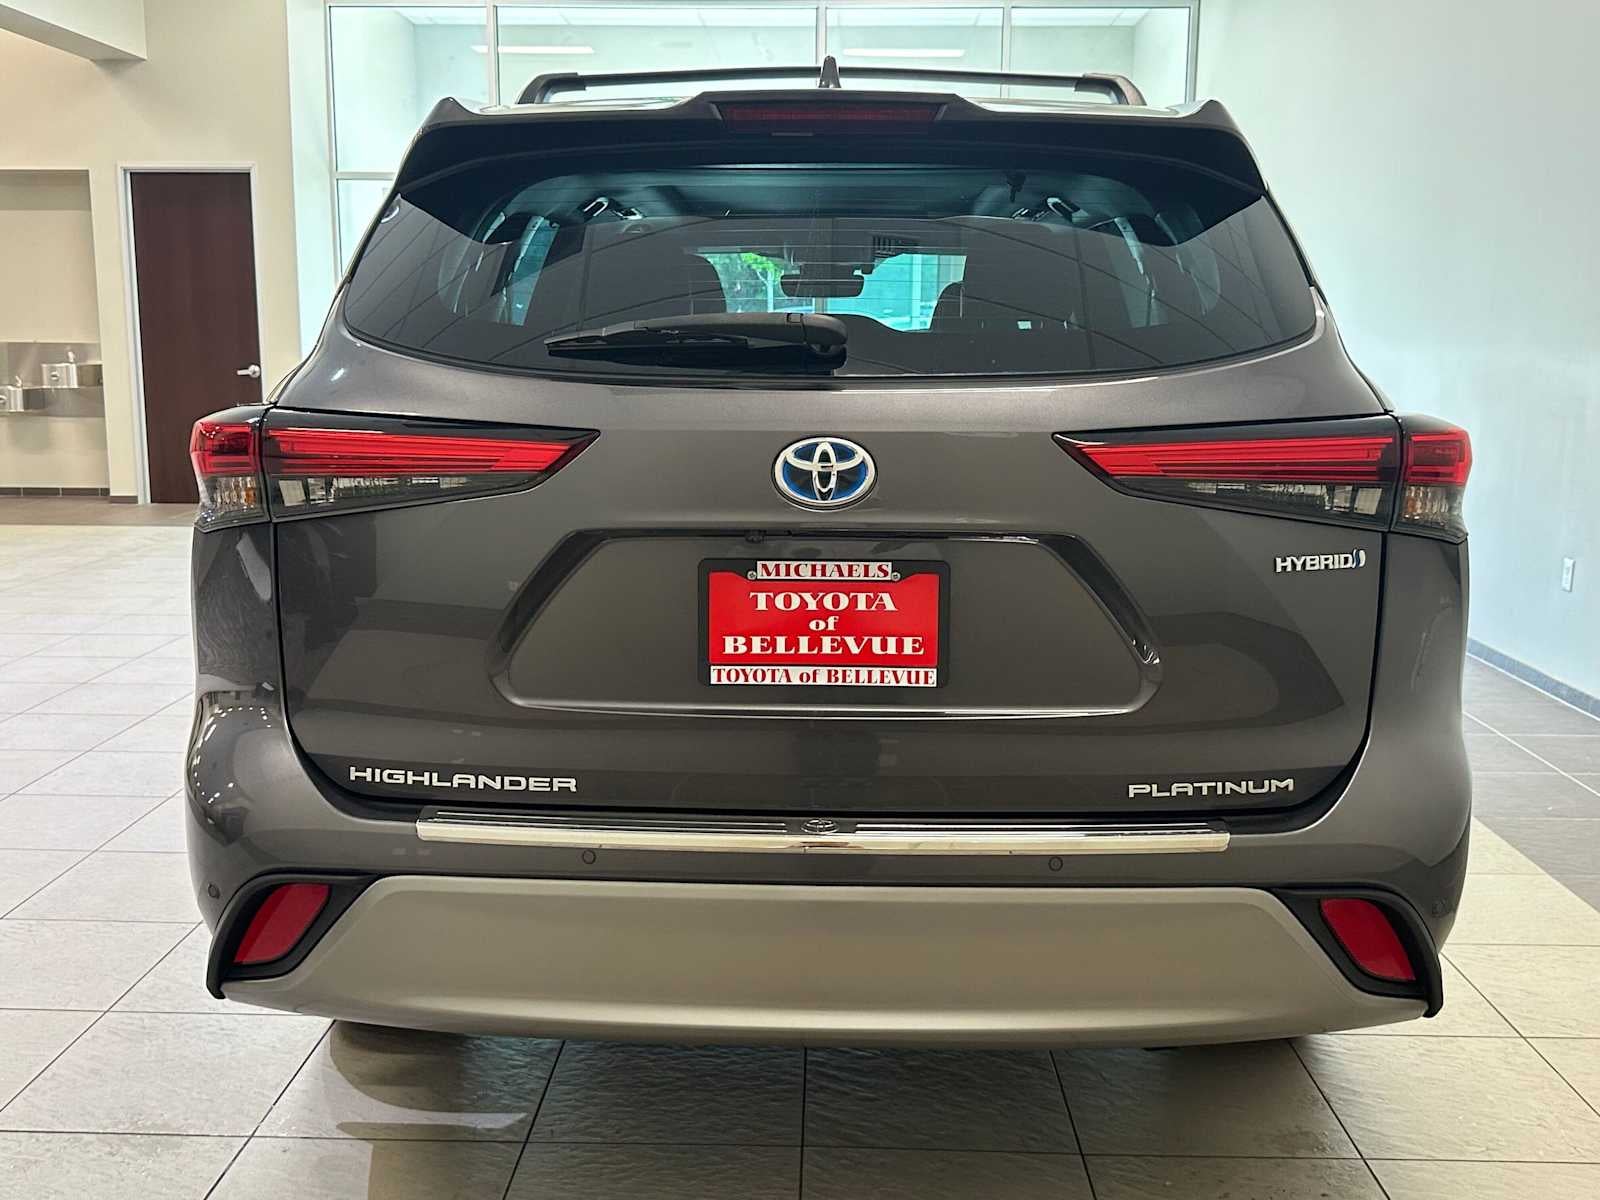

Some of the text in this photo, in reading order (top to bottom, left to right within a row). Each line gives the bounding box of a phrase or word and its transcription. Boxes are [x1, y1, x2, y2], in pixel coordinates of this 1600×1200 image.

[759, 563, 890, 579] MICHAELS
[1275, 553, 1354, 573] HYBRID
[749, 592, 897, 612] TOYOTA
[808, 616, 839, 632] of
[722, 636, 925, 656] BELLEVUE
[712, 668, 936, 686] TOYOTA of BELLEVUE
[349, 766, 578, 793] HIGHLANDER
[1127, 778, 1295, 799] PLATINUM
